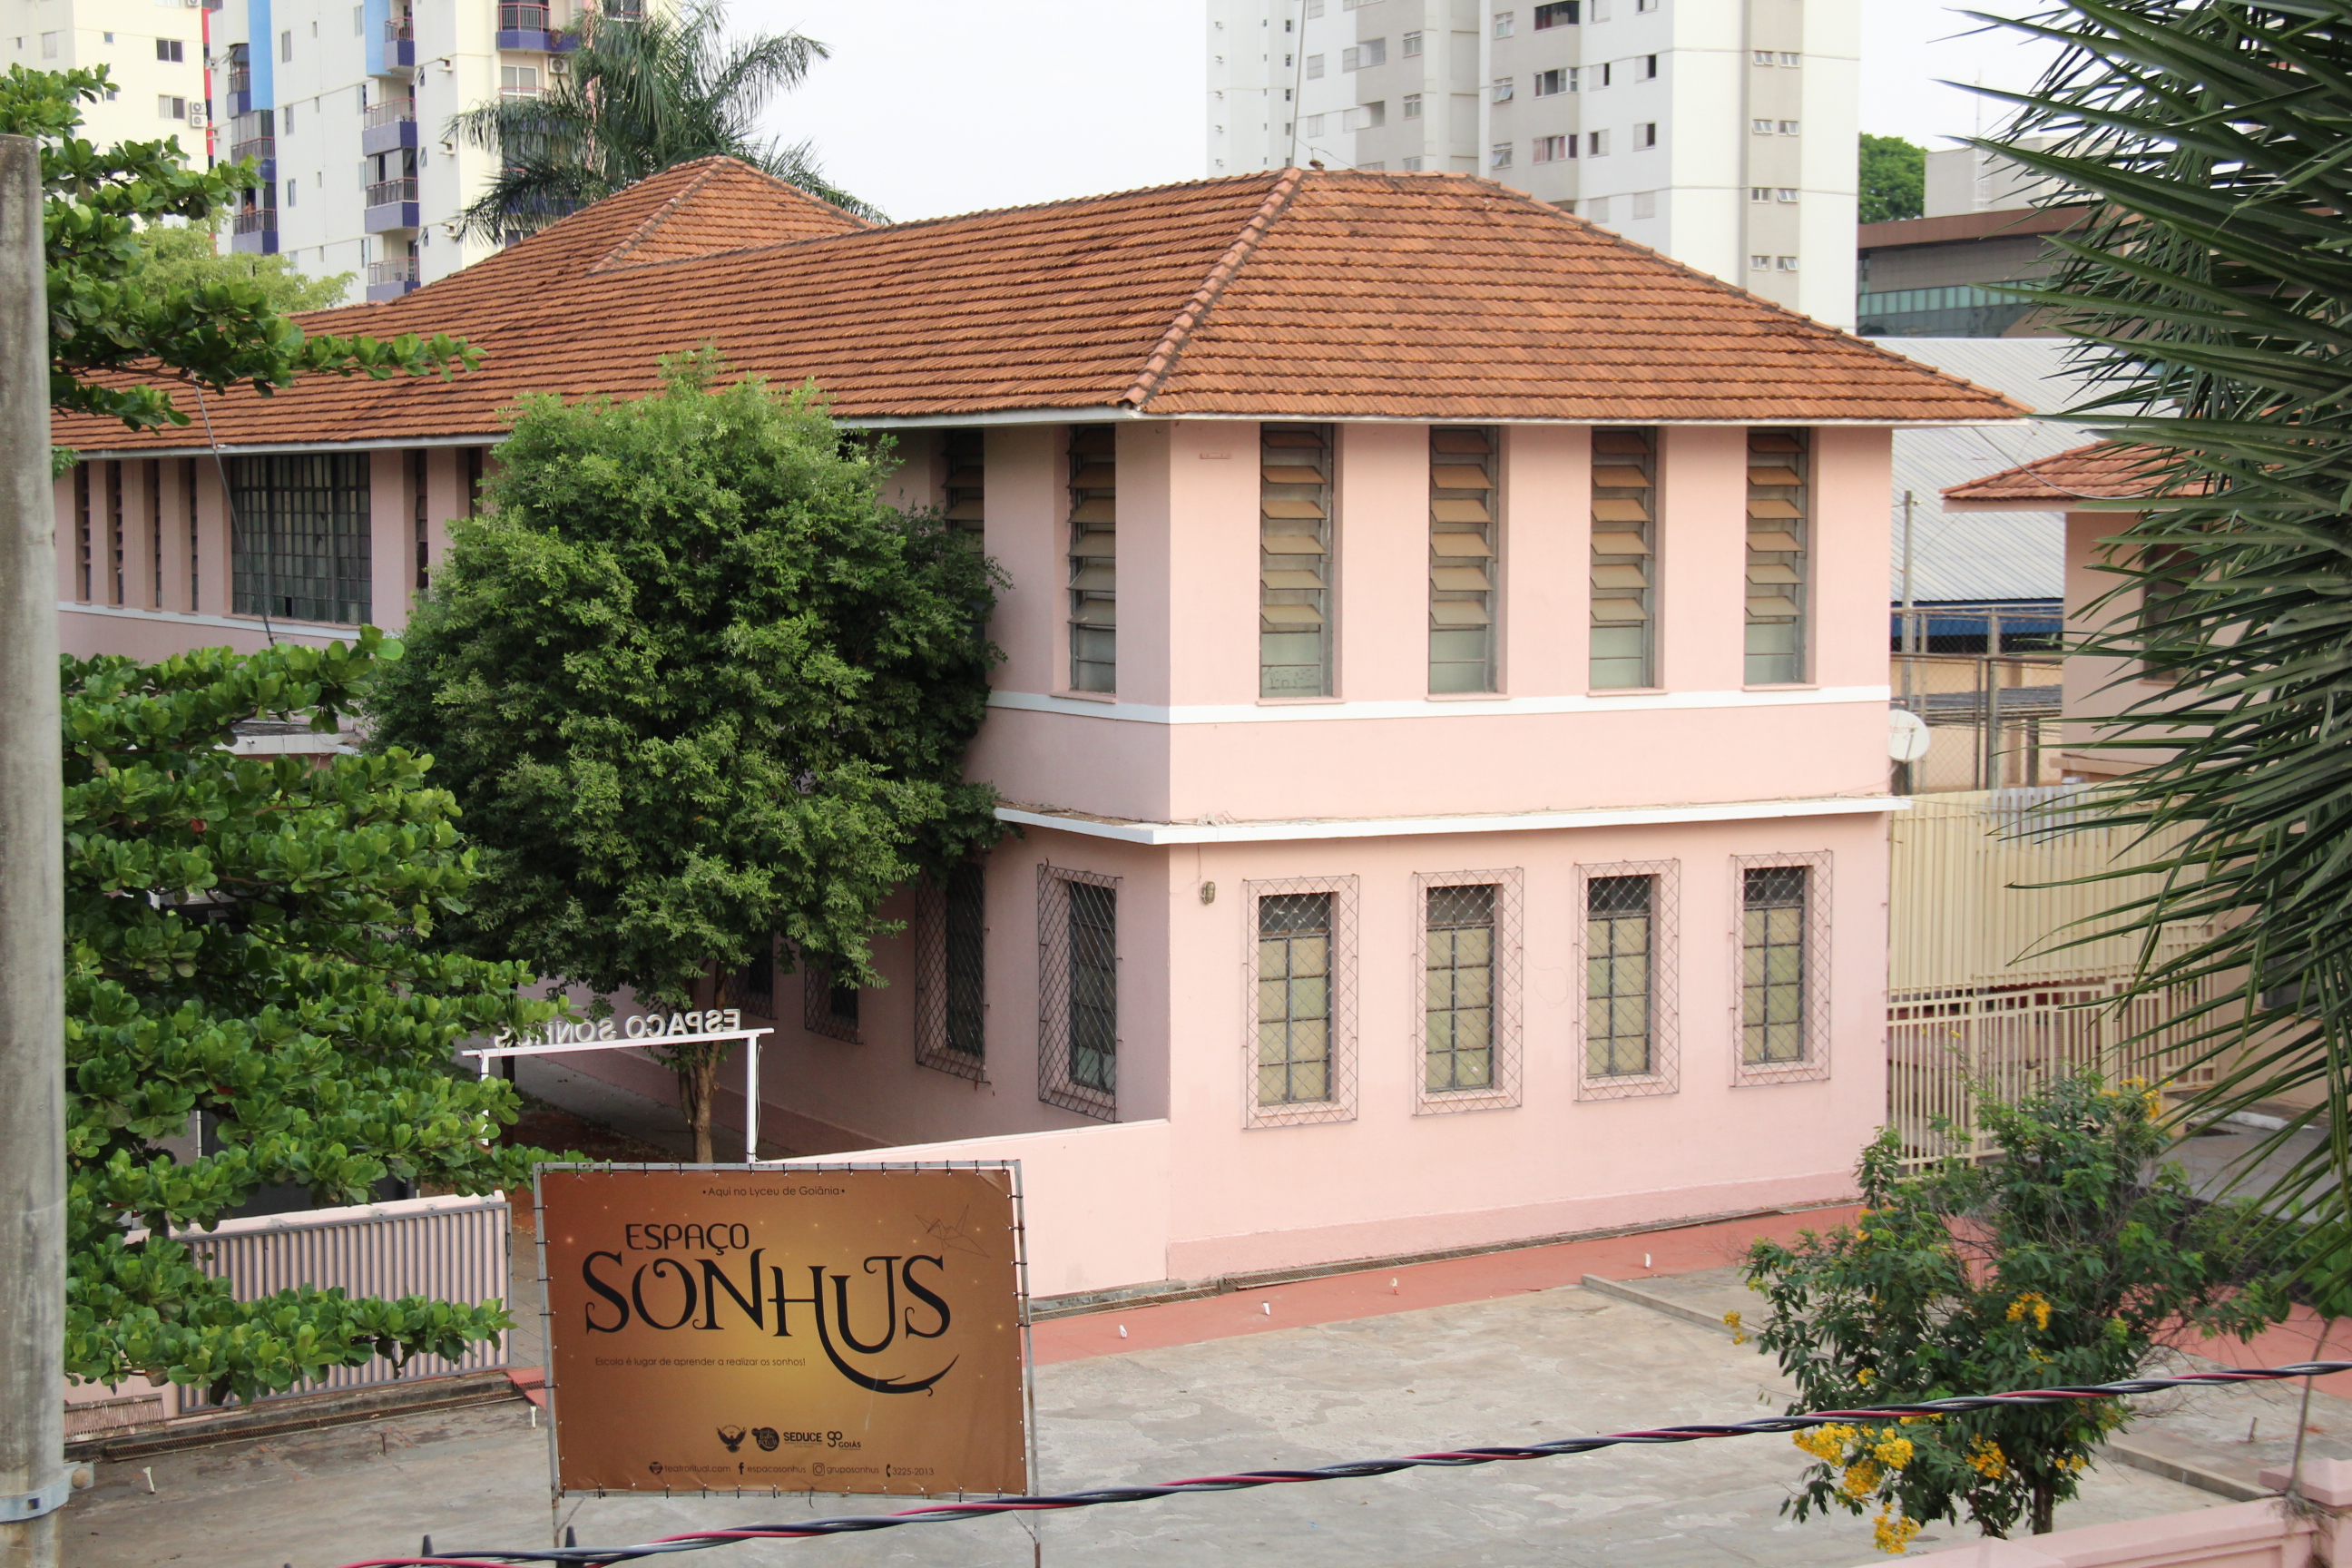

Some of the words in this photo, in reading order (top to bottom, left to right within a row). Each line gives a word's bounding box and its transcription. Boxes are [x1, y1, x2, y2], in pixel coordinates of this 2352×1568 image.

[708, 1187, 731, 1198] Aqui
[733, 1188, 747, 1196] no
[750, 1187, 779, 1198] Lyceu
[782, 1186, 797, 1196] de
[799, 1186, 840, 1196] Goiânia
[625, 1223, 750, 1256] ESPAÇO
[582, 1248, 960, 1396] SONHUS
[595, 1357, 624, 1366] Escola
[626, 1357, 632, 1366] é
[634, 1357, 656, 1367] lugar
[659, 1357, 671, 1366] de
[673, 1357, 715, 1367] aprender
[726, 1357, 758, 1366] realizar
[772, 1357, 806, 1366] sonhos!
[783, 1432, 822, 1443] SEDUCE
[892, 1467, 935, 1475] 3225-2013
